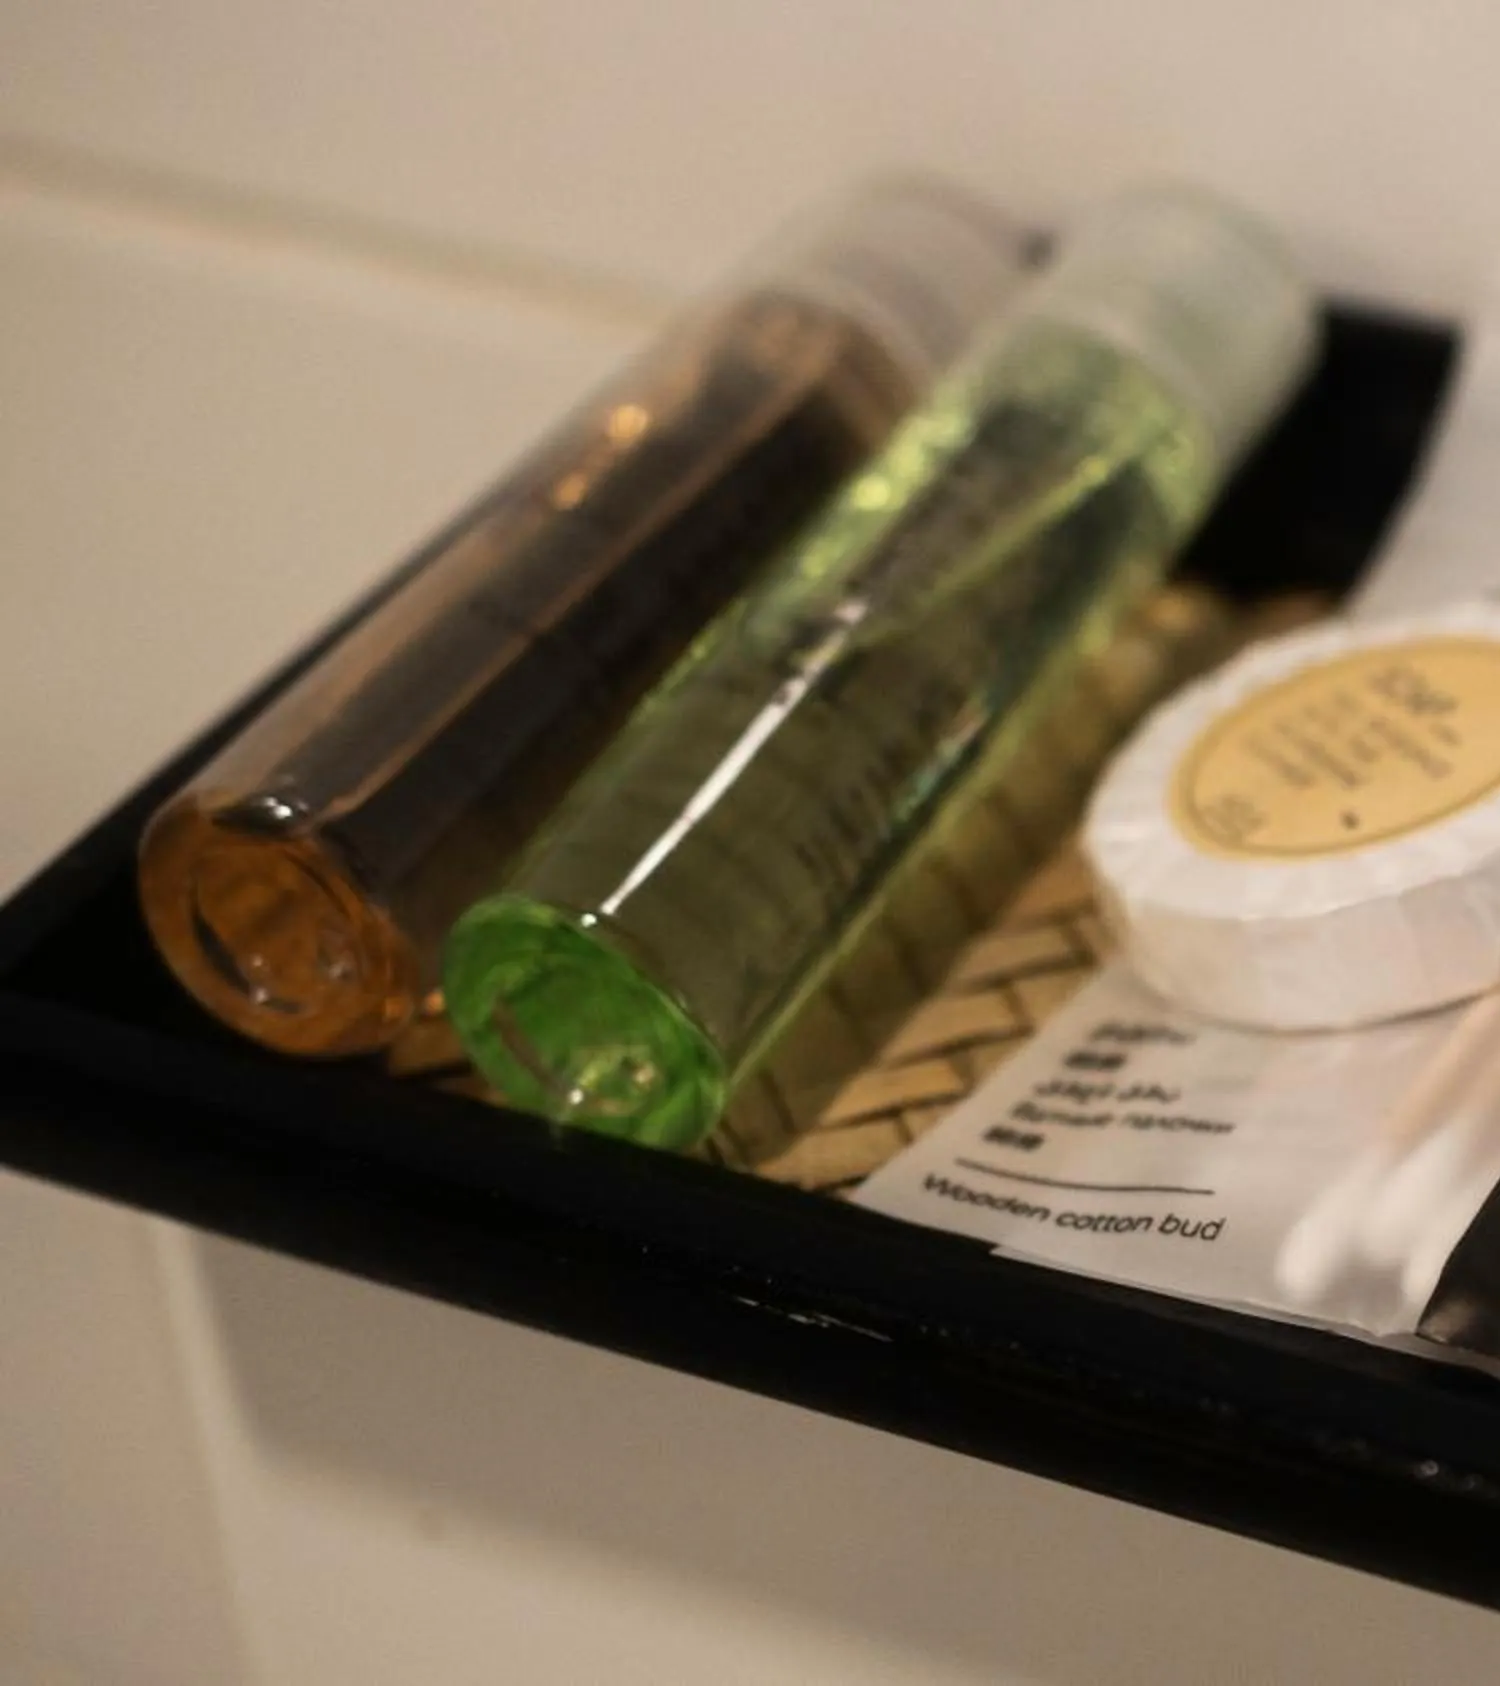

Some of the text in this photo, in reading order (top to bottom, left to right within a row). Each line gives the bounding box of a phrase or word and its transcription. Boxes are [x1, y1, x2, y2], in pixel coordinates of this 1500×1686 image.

[922, 1172, 1226, 1242] Wooden cotton bud
